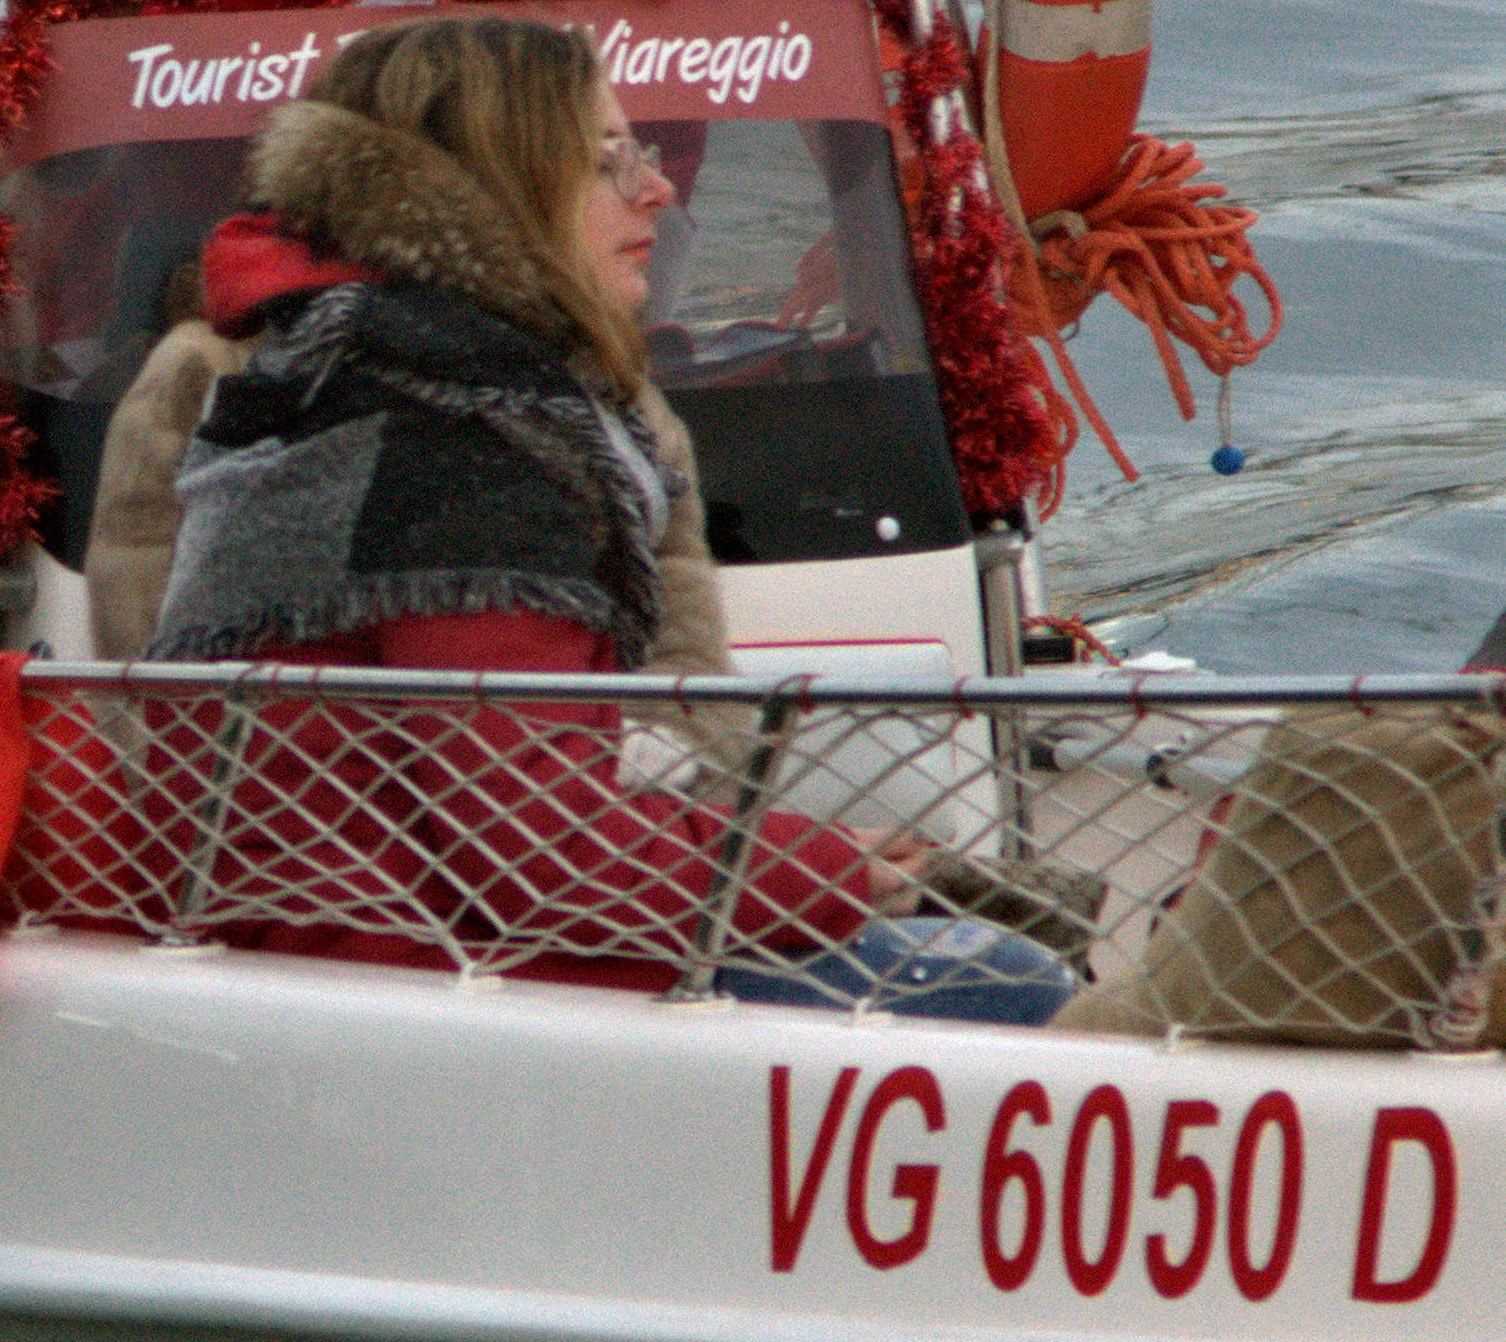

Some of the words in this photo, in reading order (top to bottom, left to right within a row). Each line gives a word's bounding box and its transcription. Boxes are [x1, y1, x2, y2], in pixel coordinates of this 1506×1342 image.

[127, 31, 322, 109] Tourist
[769, 1064, 948, 1272] VG
[980, 1079, 1306, 1303] 6050
[1350, 1105, 1460, 1304] D
